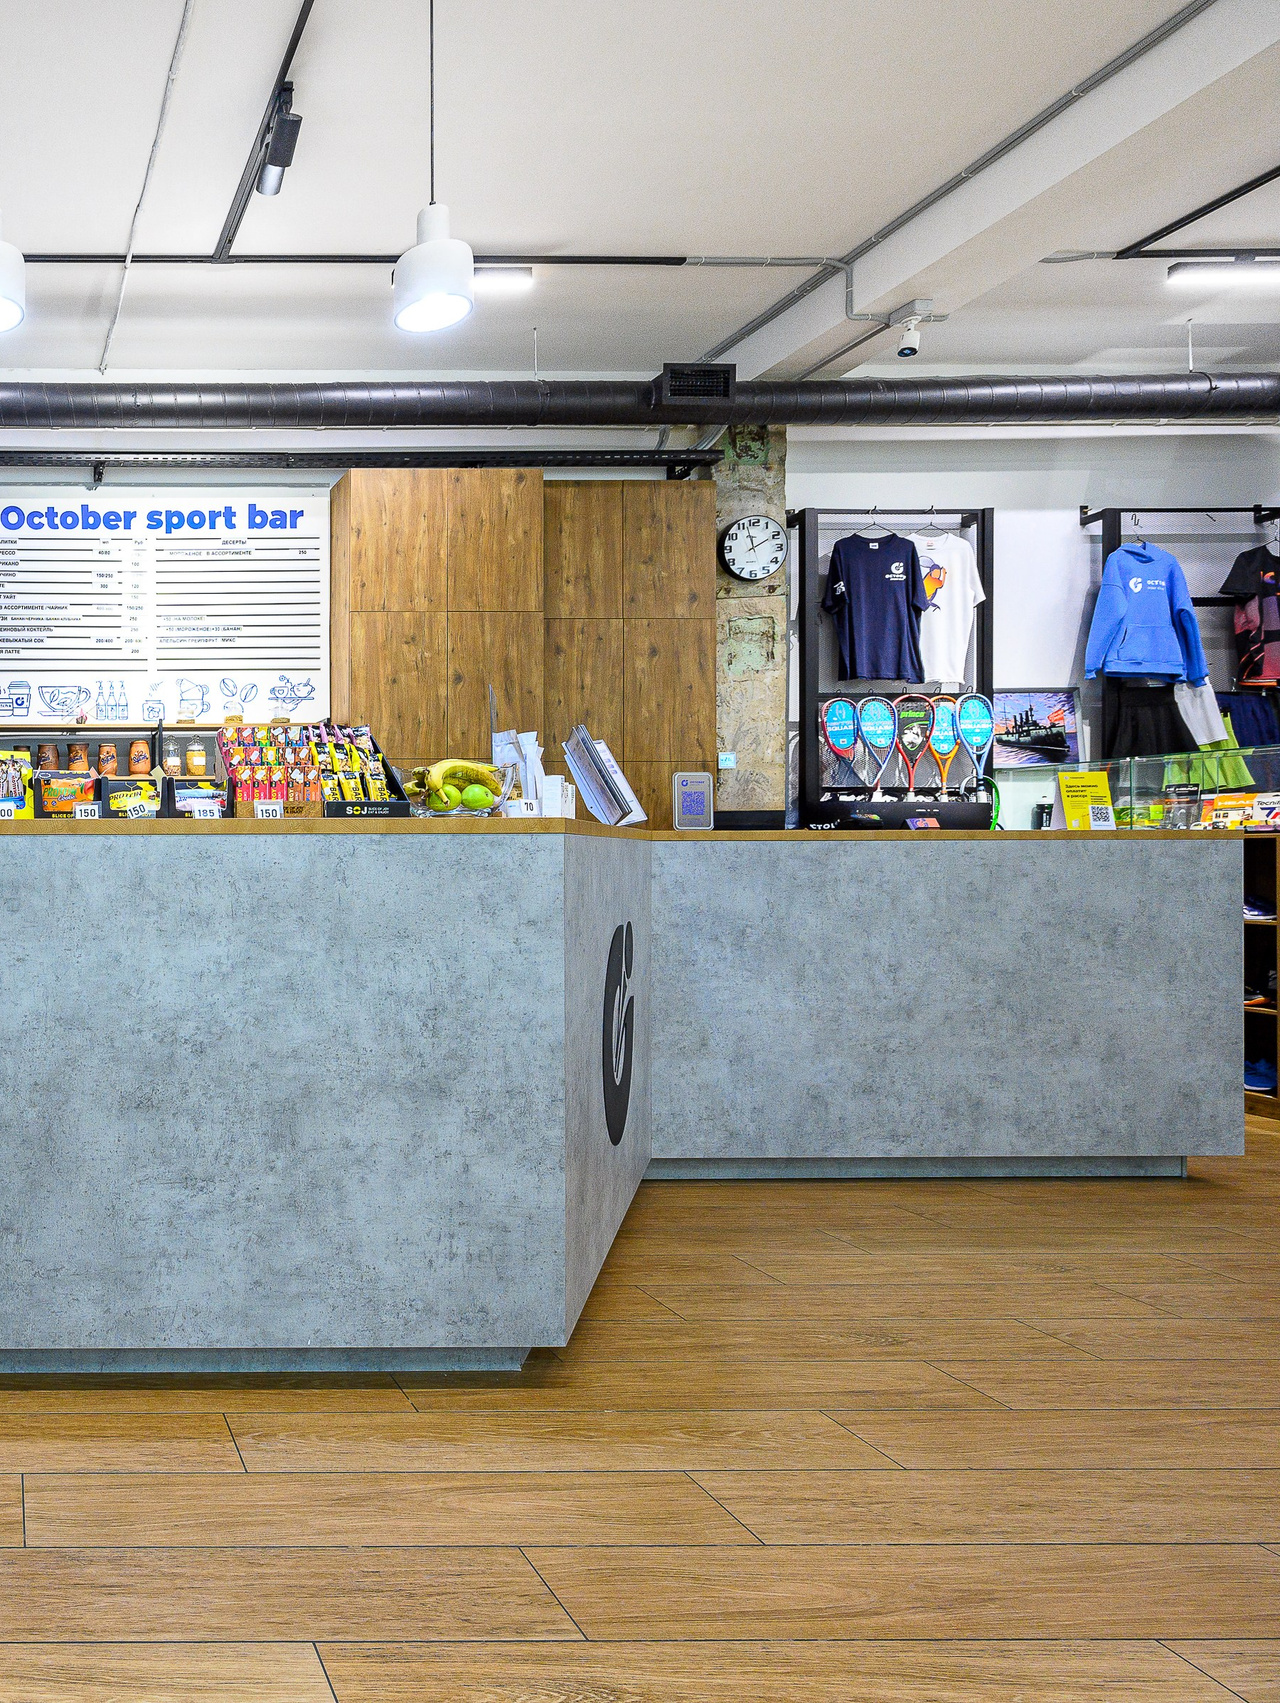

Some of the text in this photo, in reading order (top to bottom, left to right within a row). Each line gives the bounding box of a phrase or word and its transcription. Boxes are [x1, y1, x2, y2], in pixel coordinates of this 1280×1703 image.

[0, 504, 304, 534] October sport bar
[748, 518, 760, 527] 12
[737, 522, 745, 530] 11
[765, 521, 769, 529] 1
[728, 533, 738, 541] 10
[772, 531, 780, 539] 2
[724, 545, 732, 553] 9
[775, 543, 783, 552] 3
[727, 558, 735, 566] 8
[737, 567, 745, 575] 7
[749, 570, 757, 578] 6
[762, 566, 770, 574] 5
[900, 710, 926, 719] prince
[127, 803, 146, 819] 150
[346, 806, 368, 815] SOJ
[523, 802, 534, 812] 70
[79, 808, 96, 817] 150
[197, 809, 214, 817] 185
[260, 808, 278, 818] 150
